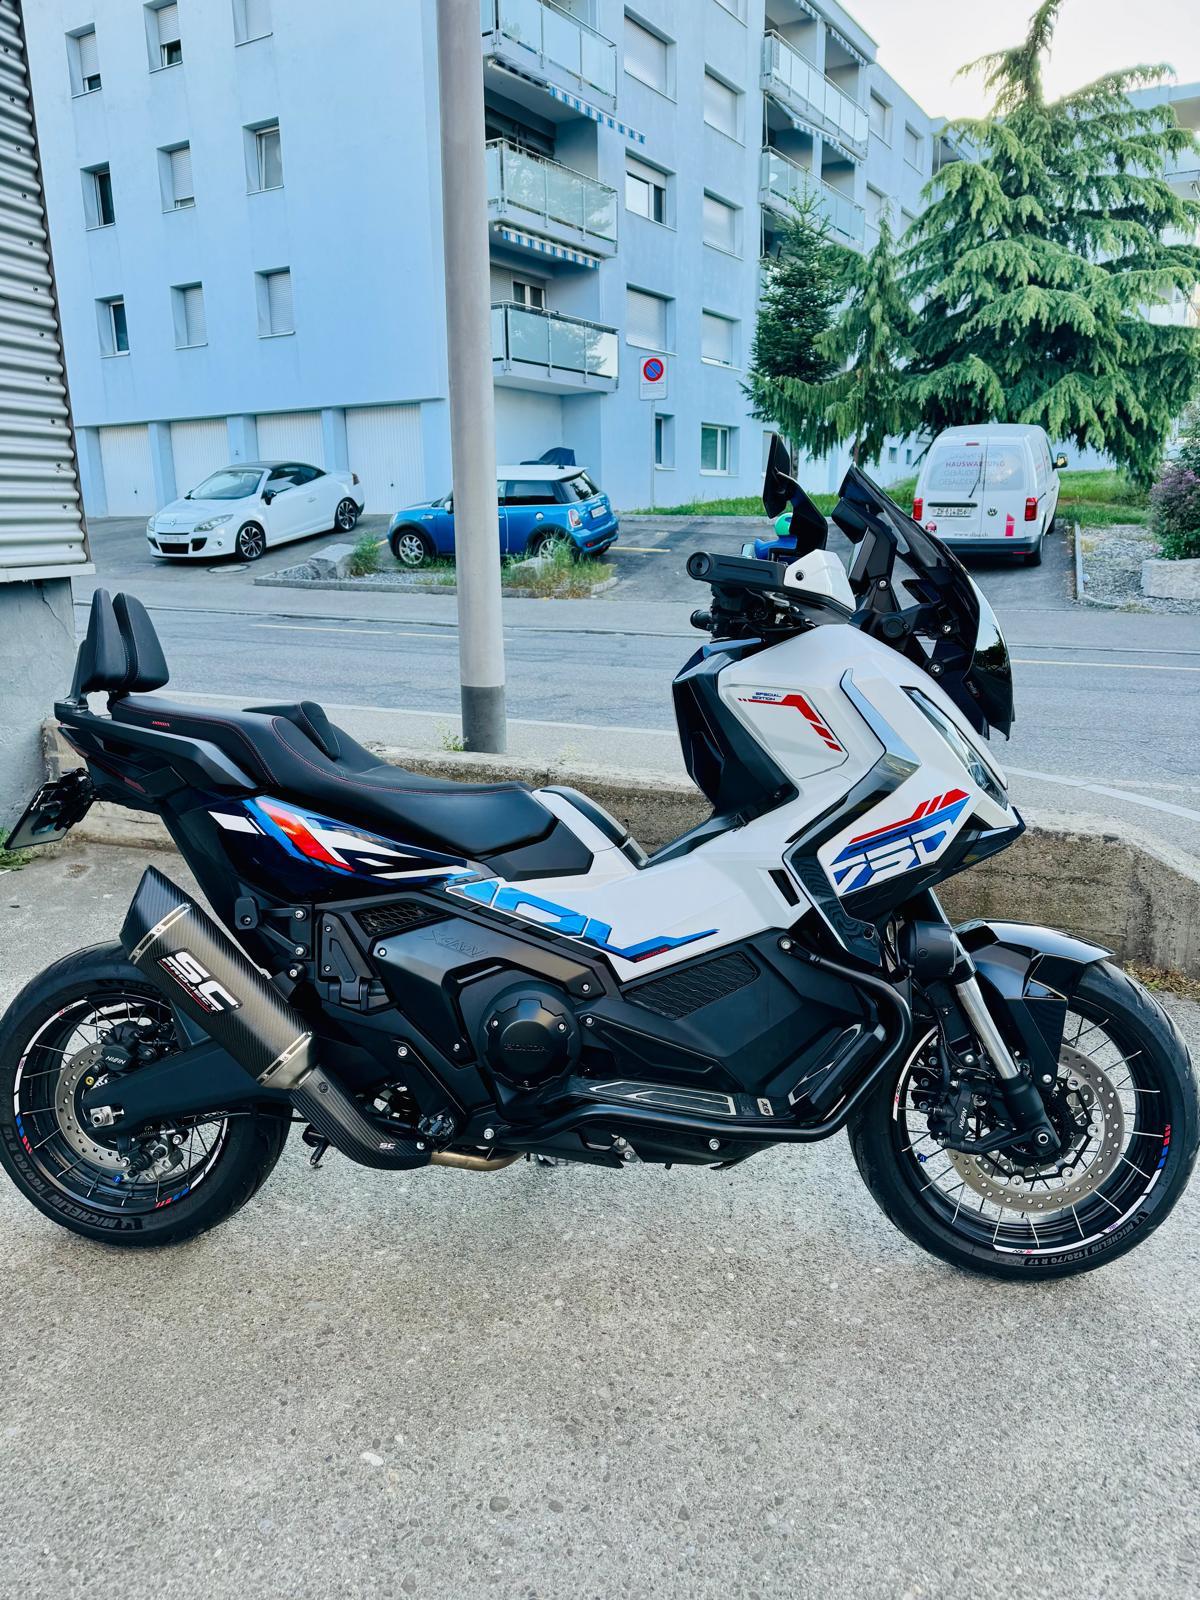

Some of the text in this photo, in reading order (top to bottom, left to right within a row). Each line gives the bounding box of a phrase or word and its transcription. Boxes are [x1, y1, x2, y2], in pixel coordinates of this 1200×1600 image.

[161, 957, 219, 1012] PROJECT
[166, 951, 239, 1011] SC
[52, 1194, 120, 1229] MICHELIN
[1091, 1221, 1135, 1254] MICHELIN
[1028, 1258, 1040, 1266] 17
[1051, 1249, 1086, 1265] 120/70
